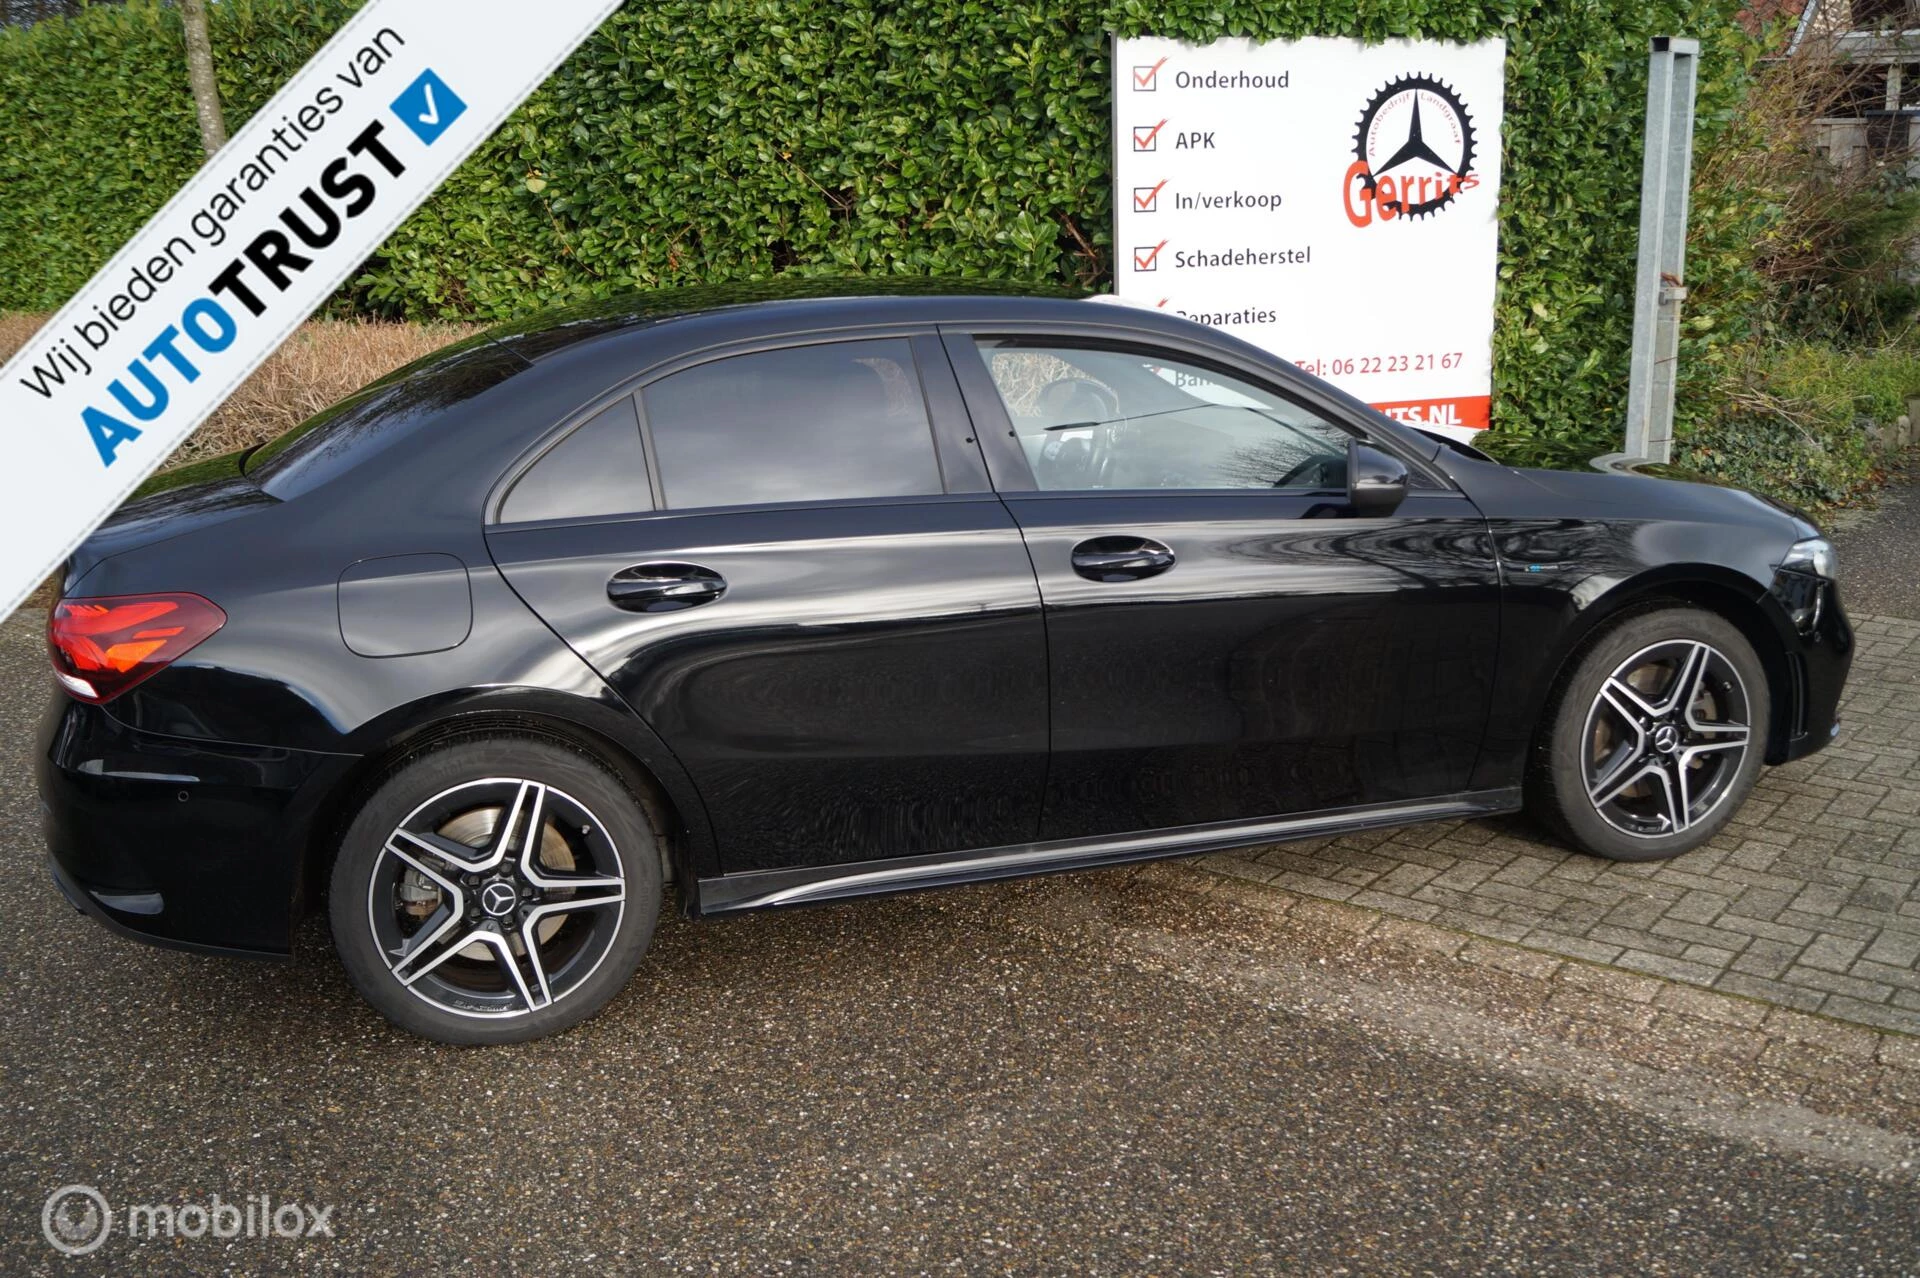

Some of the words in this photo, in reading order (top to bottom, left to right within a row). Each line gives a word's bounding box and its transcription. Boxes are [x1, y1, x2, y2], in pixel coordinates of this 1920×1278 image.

[1175, 70, 1290, 89] Onderhoud
[1175, 131, 1216, 150] APK
[1175, 190, 1283, 212] In/verkoop
[1343, 160, 1480, 228] Gerrits
[1175, 245, 1311, 268] Schadeherstel
[1176, 307, 1277, 326] eparaties
[1332, 358, 1355, 375] 06
[1359, 357, 1382, 374] 22
[1387, 355, 1409, 372] 23
[1415, 354, 1435, 371] 21
[1441, 352, 1463, 369] 67
